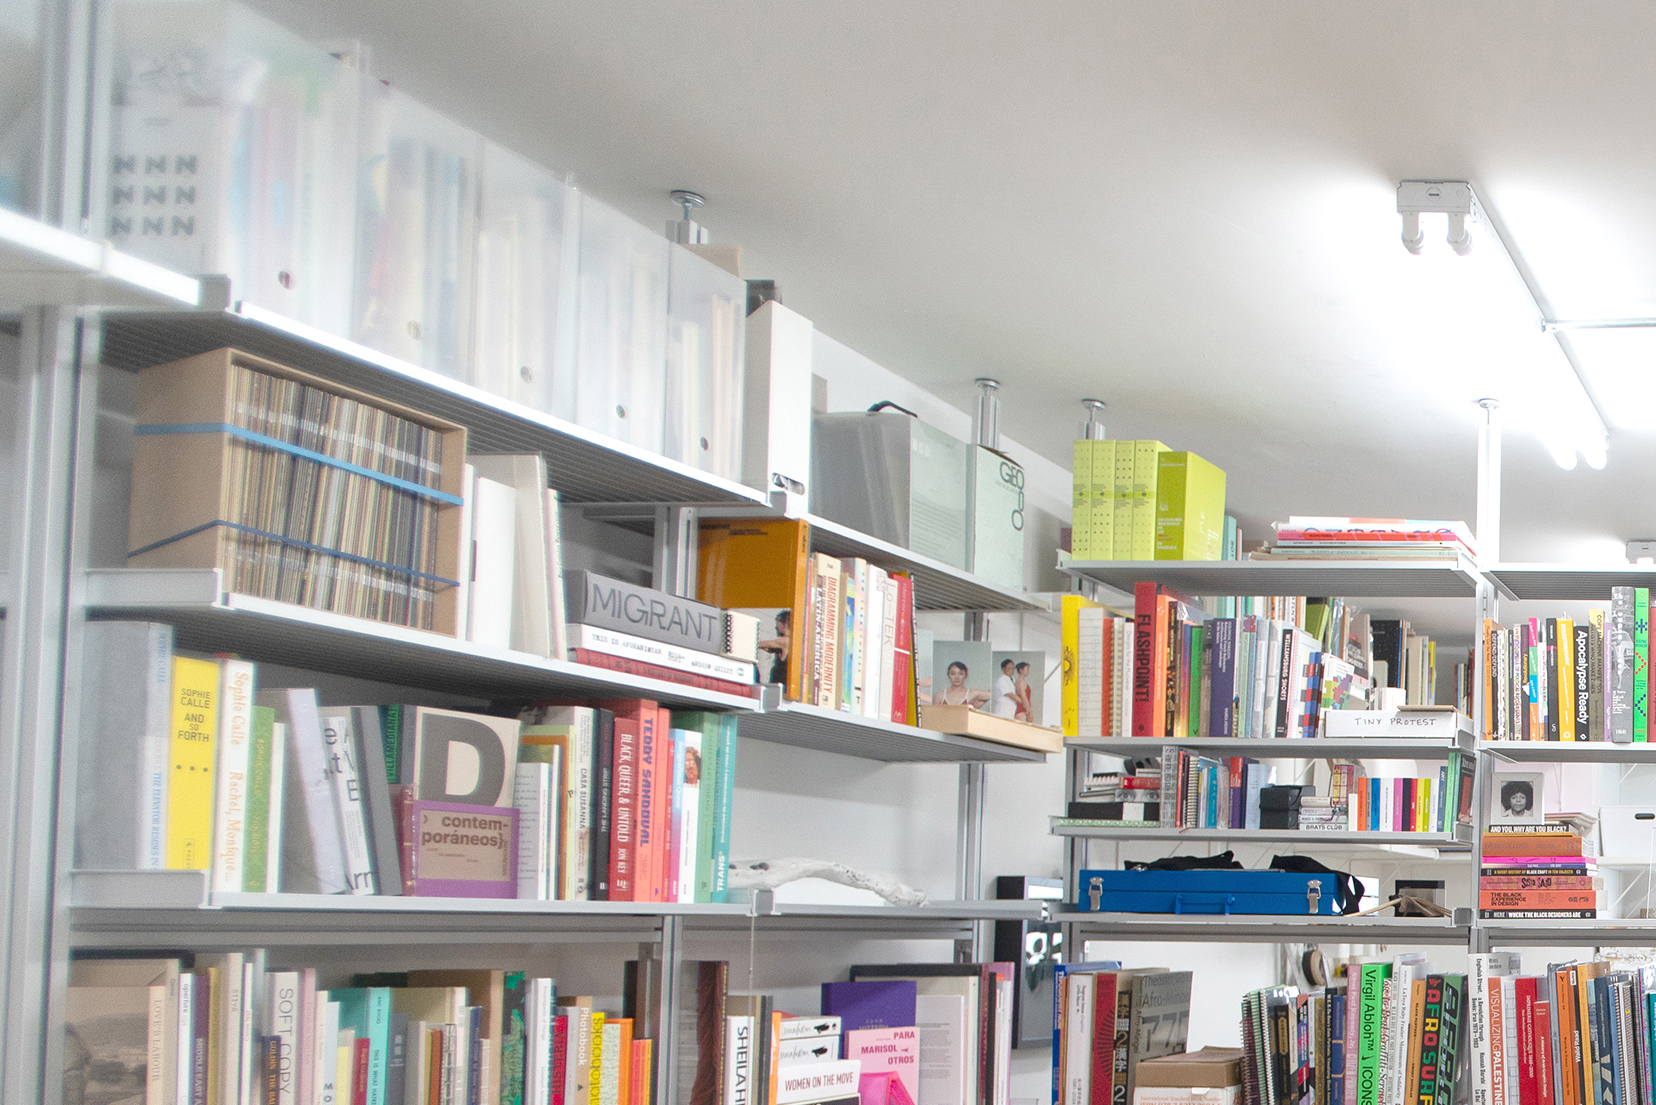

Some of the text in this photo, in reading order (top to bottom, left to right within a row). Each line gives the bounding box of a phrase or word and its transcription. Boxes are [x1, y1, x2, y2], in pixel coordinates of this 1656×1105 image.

[592, 583, 717, 642] MIGRANT
[823, 577, 838, 693] DIAGRAMMING MODERNITY
[1135, 614, 1152, 702] FLASHPOINT!
[1280, 678, 1288, 701] SHORTS
[1577, 630, 1588, 724] Apocalypse Ready
[180, 697, 210, 710] CALLE
[181, 688, 210, 700] SOPHIE
[229, 671, 249, 746] Sophie Calle
[184, 713, 205, 724] AND
[189, 723, 199, 731] SO
[1354, 717, 1436, 727] TINY PROTEST
[178, 731, 209, 743] FORTH
[618, 733, 633, 763] BLACK,
[226, 771, 244, 815] Rachel,
[617, 765, 632, 797] QUEER,
[639, 718, 654, 848] TEDDY SANDOVAL
[579, 768, 588, 829] CASA SUSANNA
[616, 807, 630, 843] UNTOLD
[1363, 969, 1377, 1001] Virgil
[278, 988, 294, 1037] SOFT
[1424, 989, 1441, 1046] AFRO
[577, 1007, 589, 1066] Photobook
[861, 1044, 897, 1055] MARISOL
[893, 1031, 916, 1041] PARA
[277, 1043, 292, 1094] COPY
[736, 1026, 749, 1087] SHEILA
[887, 1056, 915, 1066] OTROS
[784, 1072, 854, 1092] WOMEN ON THE MOVE
[1113, 1085, 1125, 1102] 2
